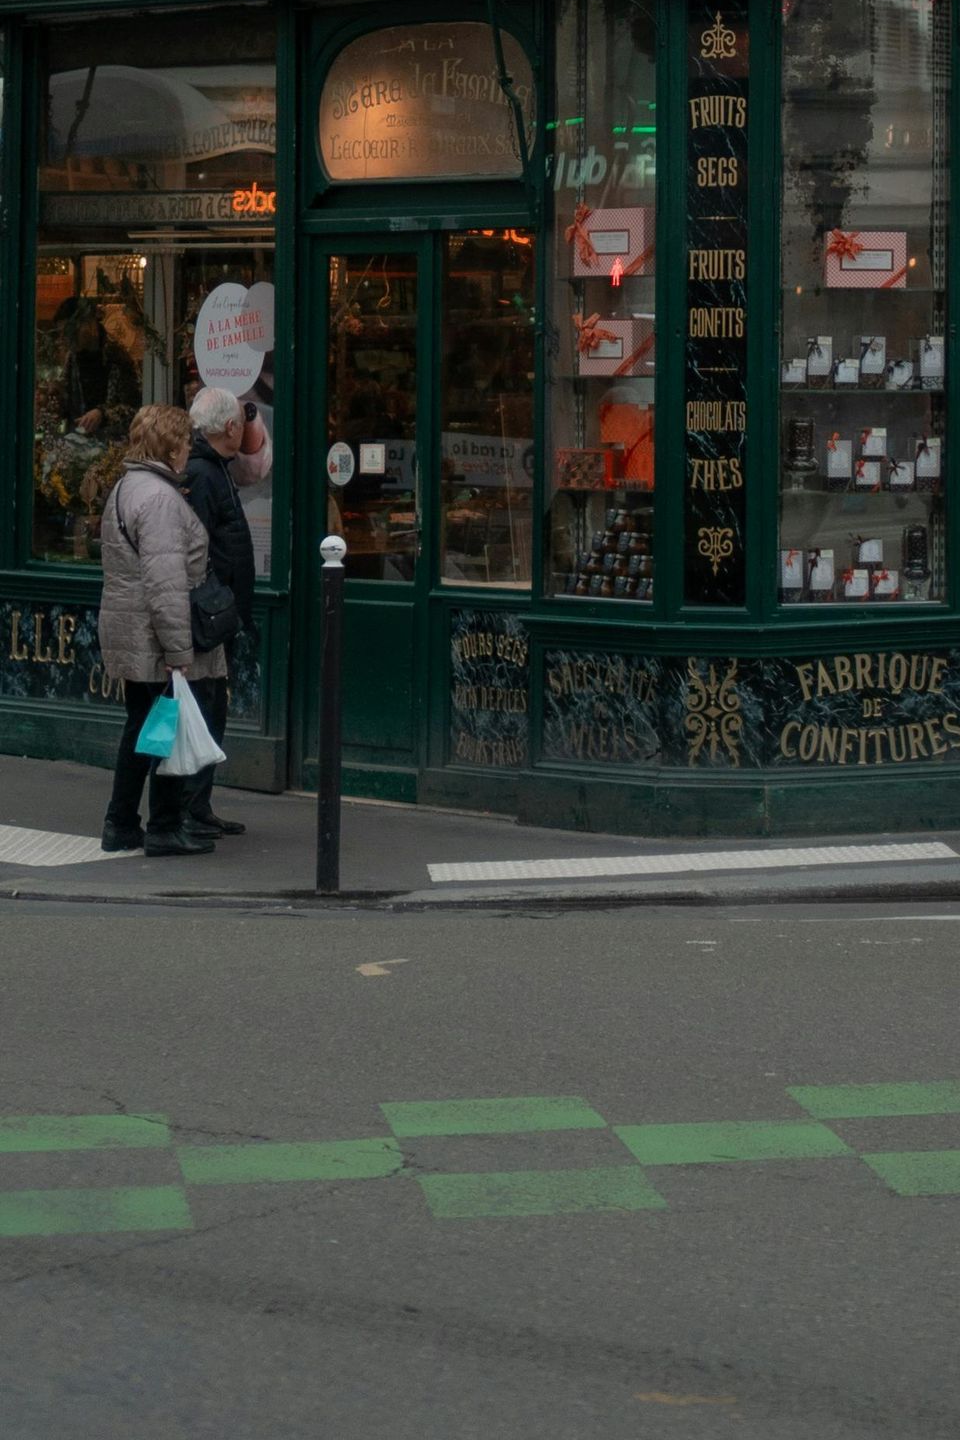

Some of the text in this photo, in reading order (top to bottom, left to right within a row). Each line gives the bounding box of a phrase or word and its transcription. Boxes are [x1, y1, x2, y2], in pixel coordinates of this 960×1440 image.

[689, 95, 747, 130] FRUITS
[697, 157, 738, 188] SECS
[689, 249, 746, 281] FRUITS
[206, 326, 266, 352] DE FAMILLE
[689, 306, 745, 339] CONFITS
[686, 400, 747, 434] CHOCOLATS
[690, 456, 743, 492] THÉS
[798, 653, 949, 702] FABRIQUE
[863, 697, 883, 718] DE
